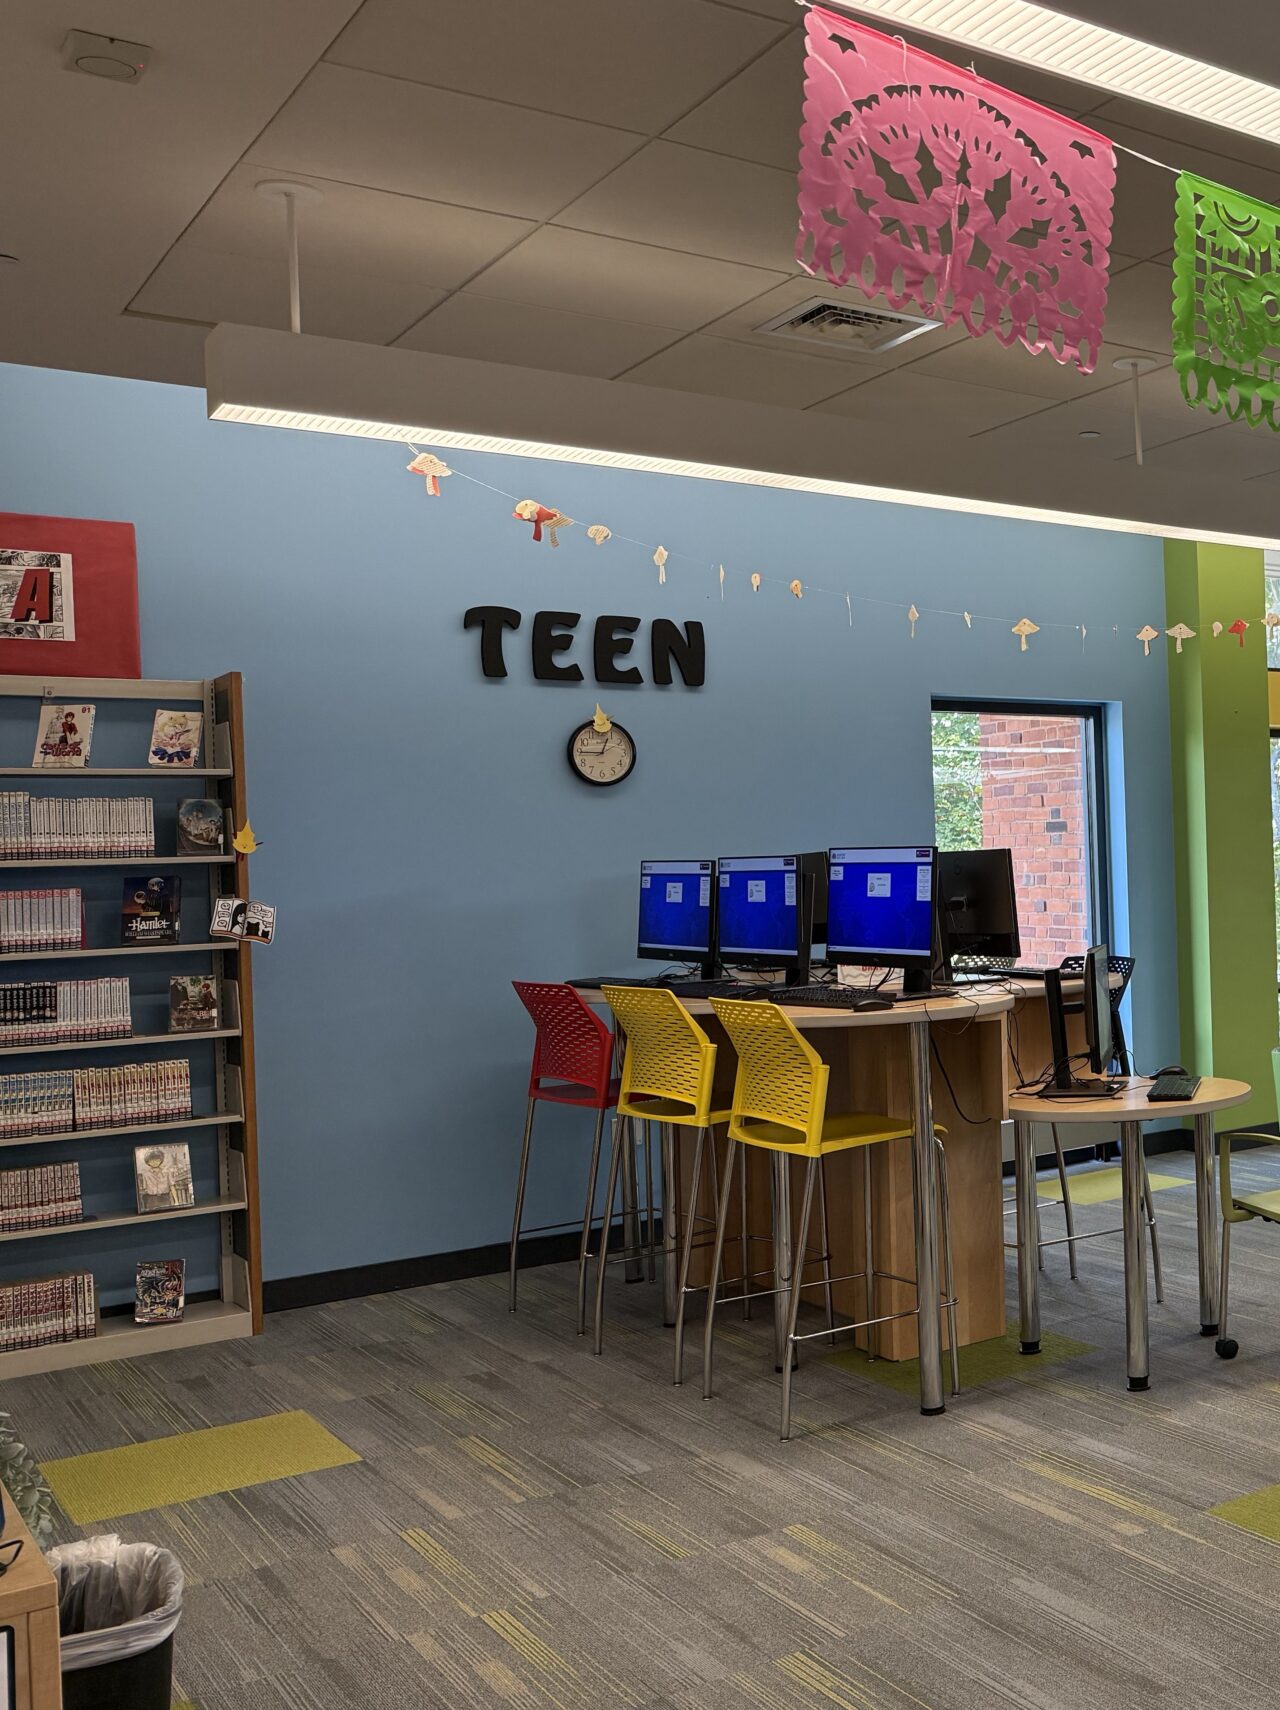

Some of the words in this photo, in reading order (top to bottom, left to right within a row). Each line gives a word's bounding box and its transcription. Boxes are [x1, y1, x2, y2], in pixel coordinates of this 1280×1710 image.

[464, 605, 706, 687] TEEN
[580, 737, 589, 747] 10
[580, 758, 586, 768] 8
[616, 759, 623, 768] 4
[588, 765, 595, 775] 7
[599, 769, 606, 779] 6
[610, 766, 616, 776] 5
[128, 916, 171, 931] Hamlet
